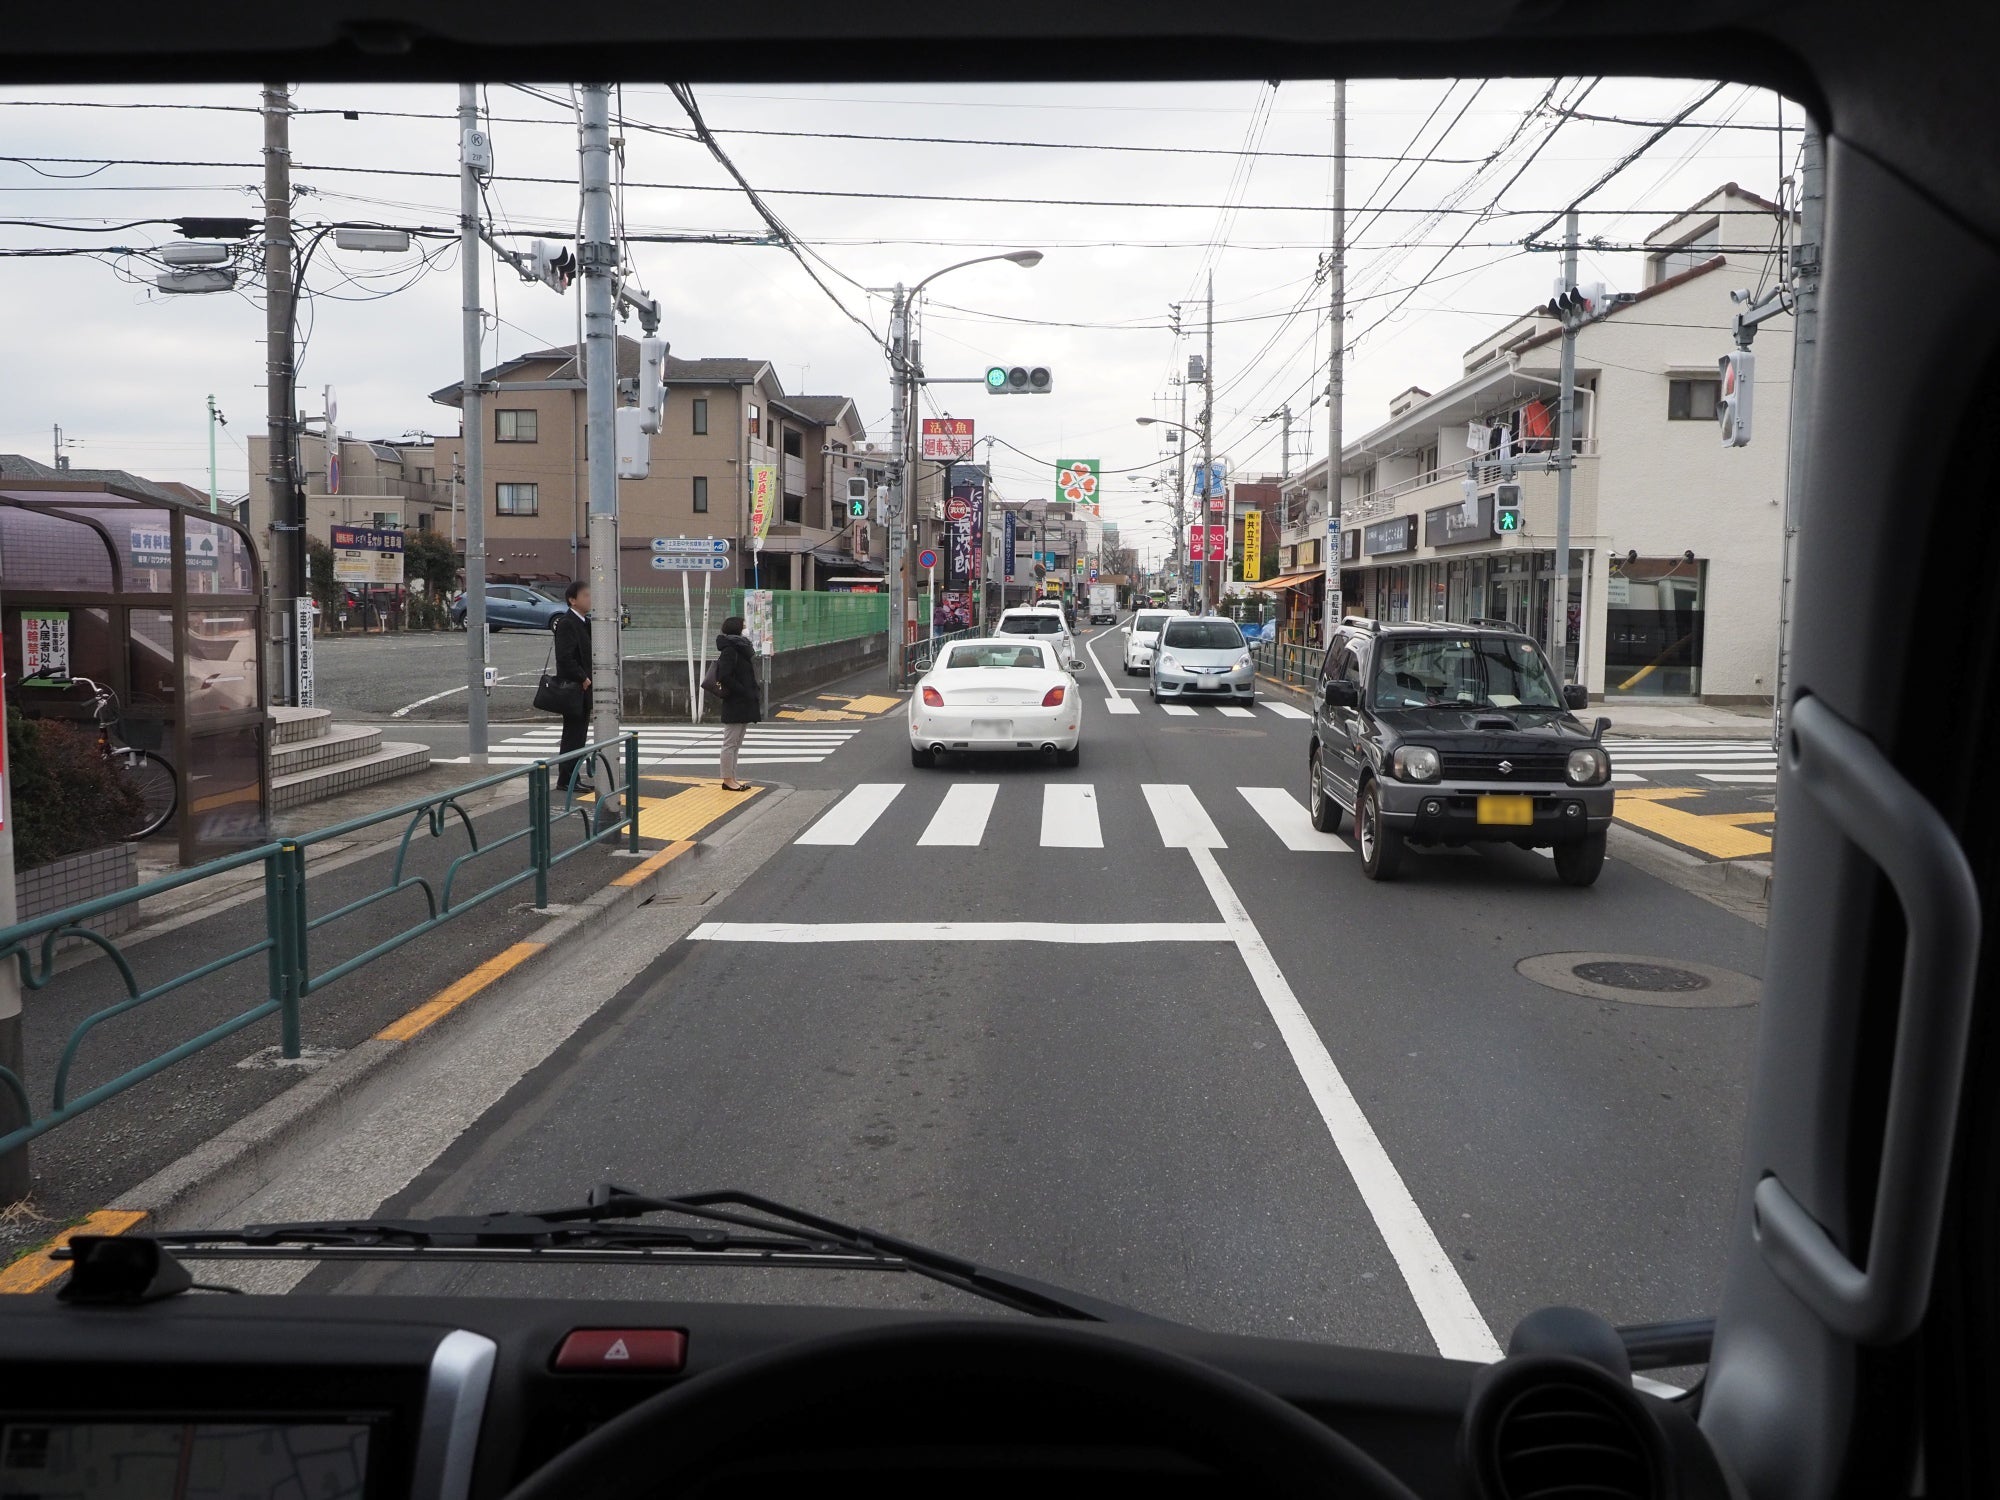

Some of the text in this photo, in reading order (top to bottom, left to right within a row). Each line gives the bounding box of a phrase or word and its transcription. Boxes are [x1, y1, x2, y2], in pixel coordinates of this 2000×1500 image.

[924, 438, 971, 456] 廻転寿司
[1192, 533, 1223, 542] DASO
[1331, 593, 1339, 624] 自転車は
